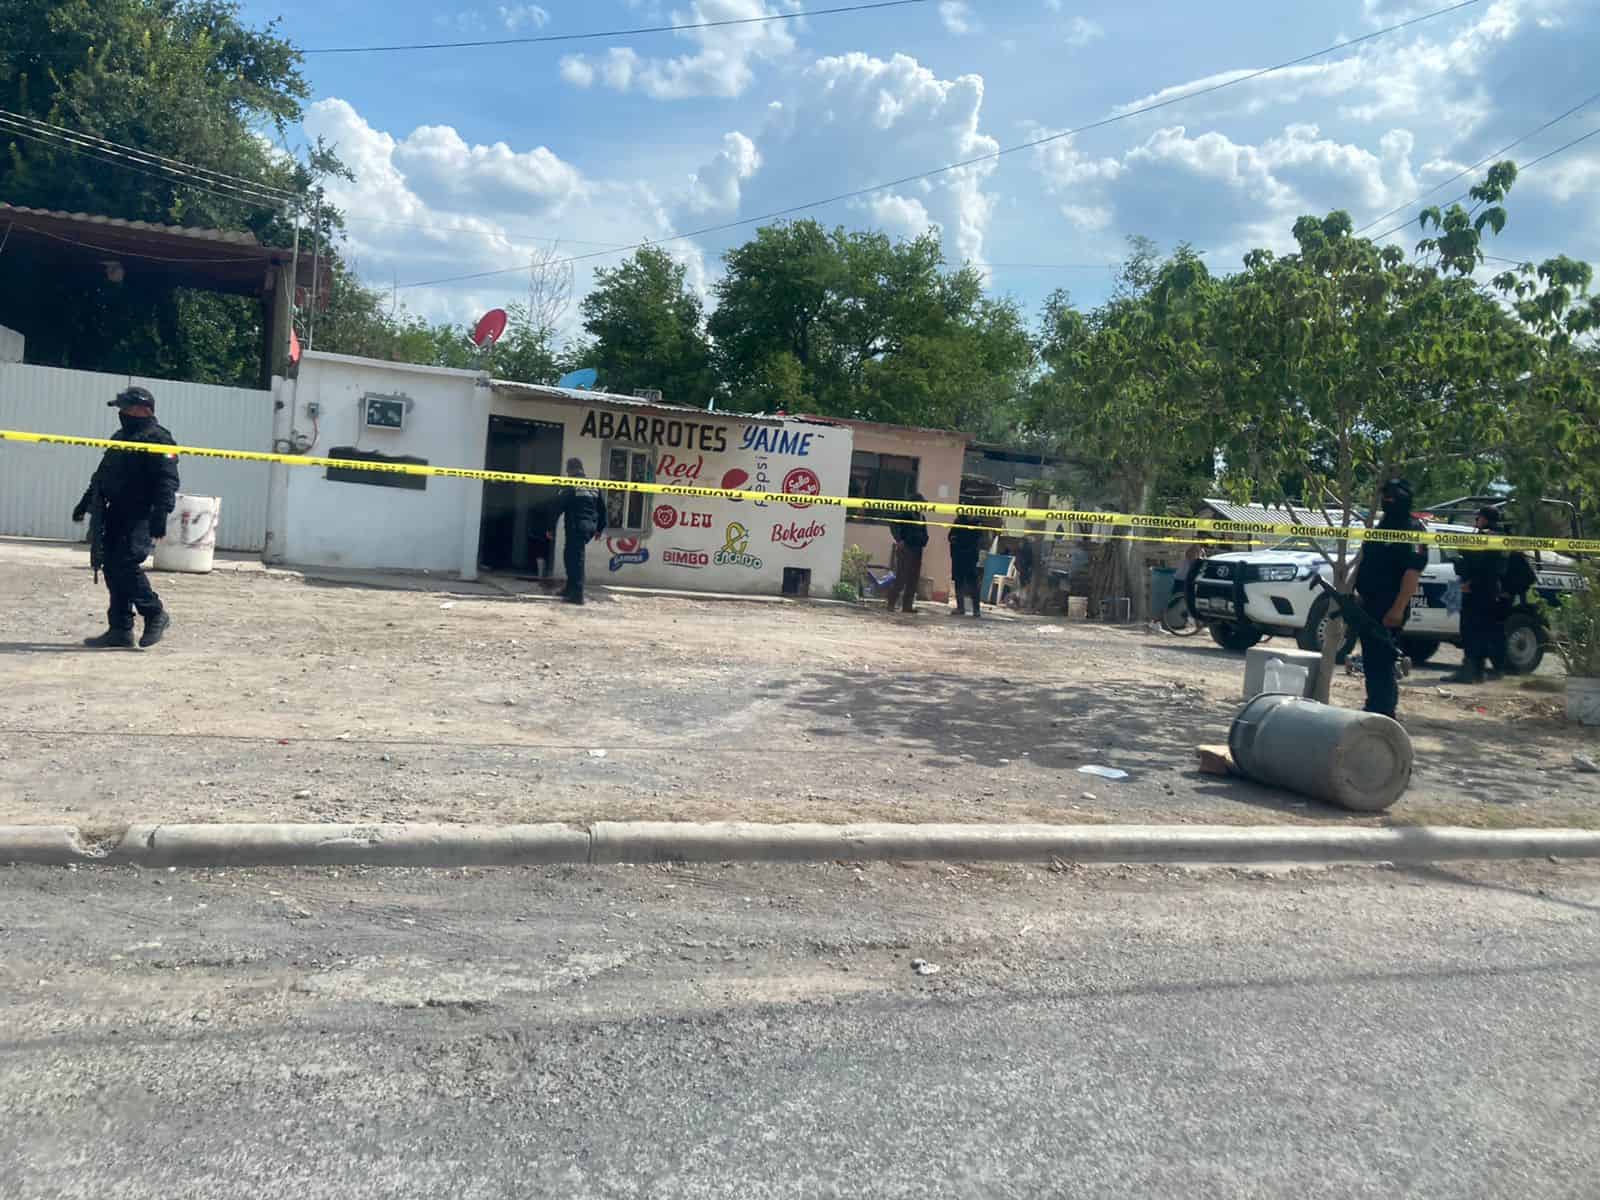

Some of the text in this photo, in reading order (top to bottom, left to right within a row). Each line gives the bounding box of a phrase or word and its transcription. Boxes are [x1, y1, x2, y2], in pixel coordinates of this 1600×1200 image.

[580, 409, 727, 453] ABARROTES
[655, 454, 703, 480] Red
[862, 501, 936, 513] PROHIBIDO
[955, 506, 1026, 518] PROHIBIDO
[1046, 511, 1113, 523] PROHIBIDO
[1131, 517, 1197, 529] PROHIBIDO
[771, 520, 825, 542] Bokados
[1212, 521, 1275, 534] PROHIBIDO
[1290, 525, 1349, 538] PROHIBIDO
[1363, 530, 1420, 542] PROHIBIDO
[1434, 534, 1489, 545] PROHIBIDO
[663, 551, 709, 566] BIMBO
